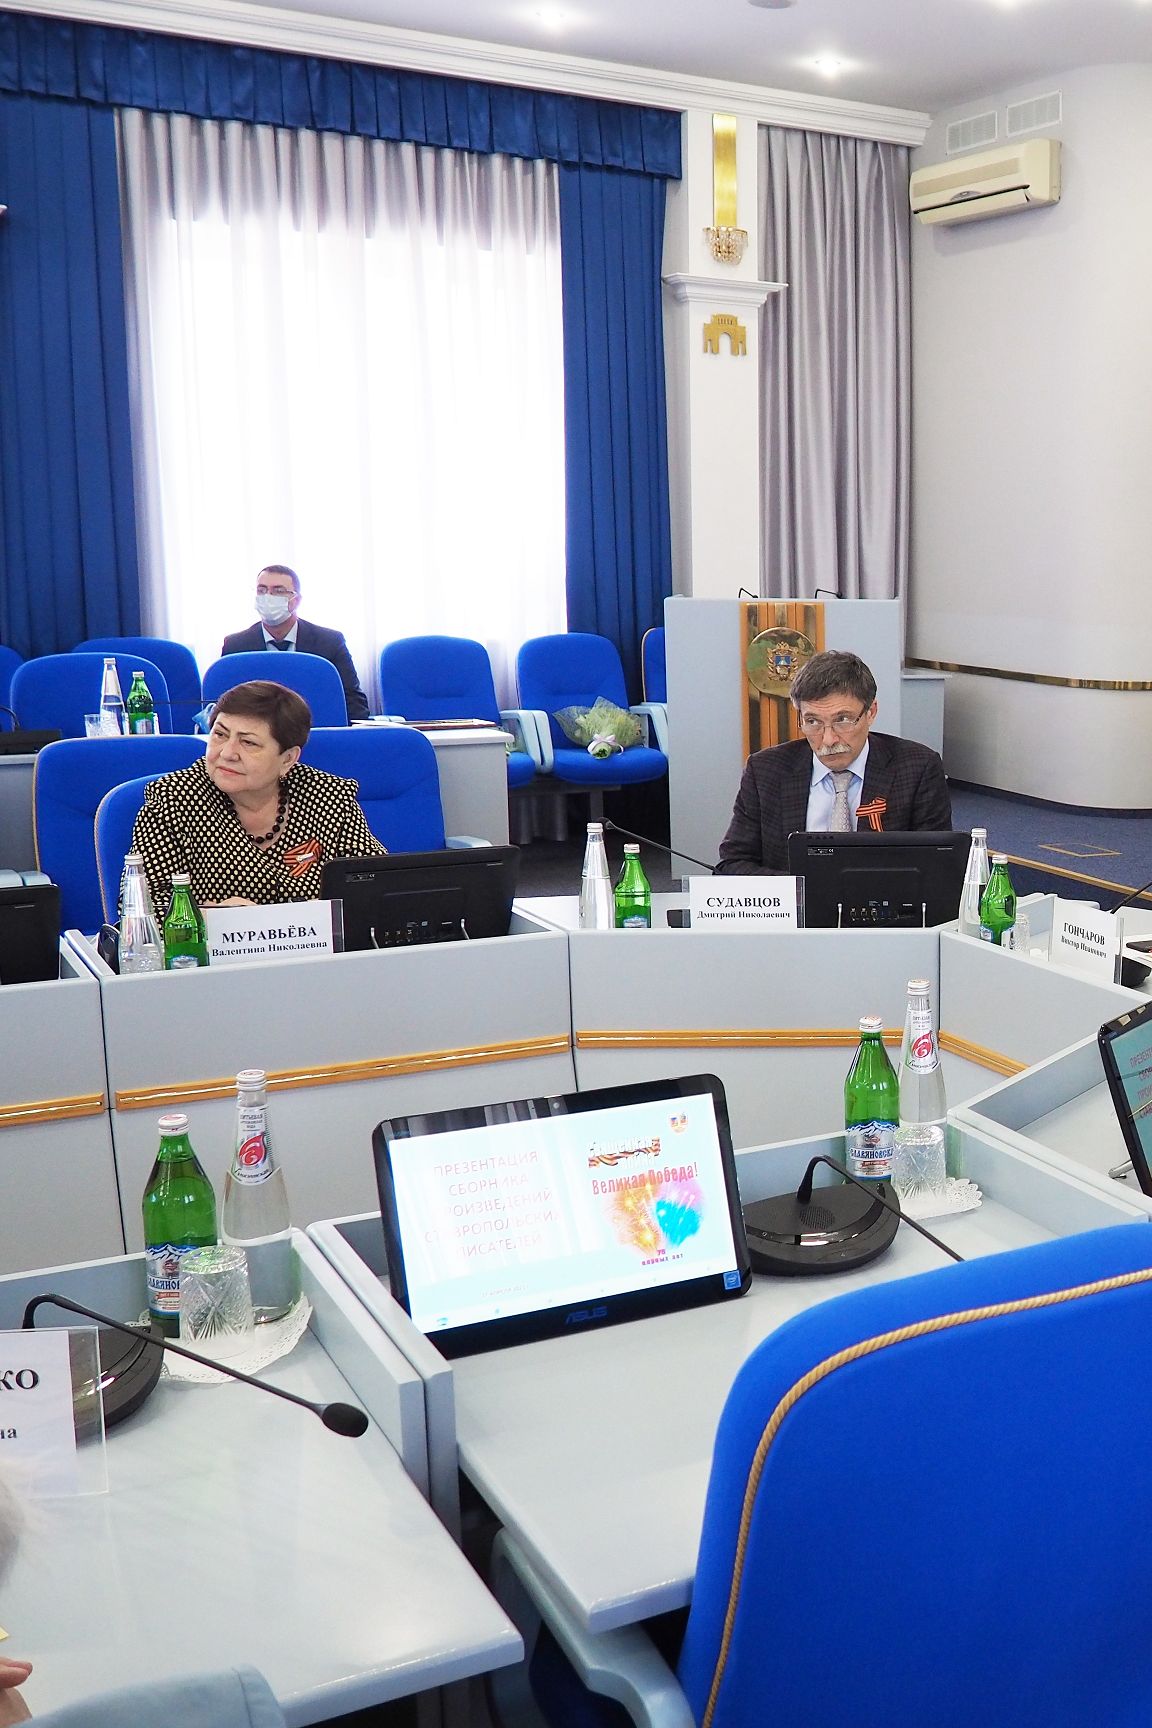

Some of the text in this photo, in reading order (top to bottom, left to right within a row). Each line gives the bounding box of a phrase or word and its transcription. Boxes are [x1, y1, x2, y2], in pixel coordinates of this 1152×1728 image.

[706, 897, 781, 908] СУДАВЦОВ
[697, 910, 736, 920] Дмитрий
[222, 925, 317, 943] МУРАВЬЁВА
[1063, 922, 1105, 945] ГОНЧАРОВ
[212, 941, 327, 957] Валентина Николаевна
[434, 1151, 539, 1177] ПРЕЗЕНТАЦИЯ
[592, 1162, 699, 1196] Великая Победа!
[565, 1305, 608, 1325] ASUS
